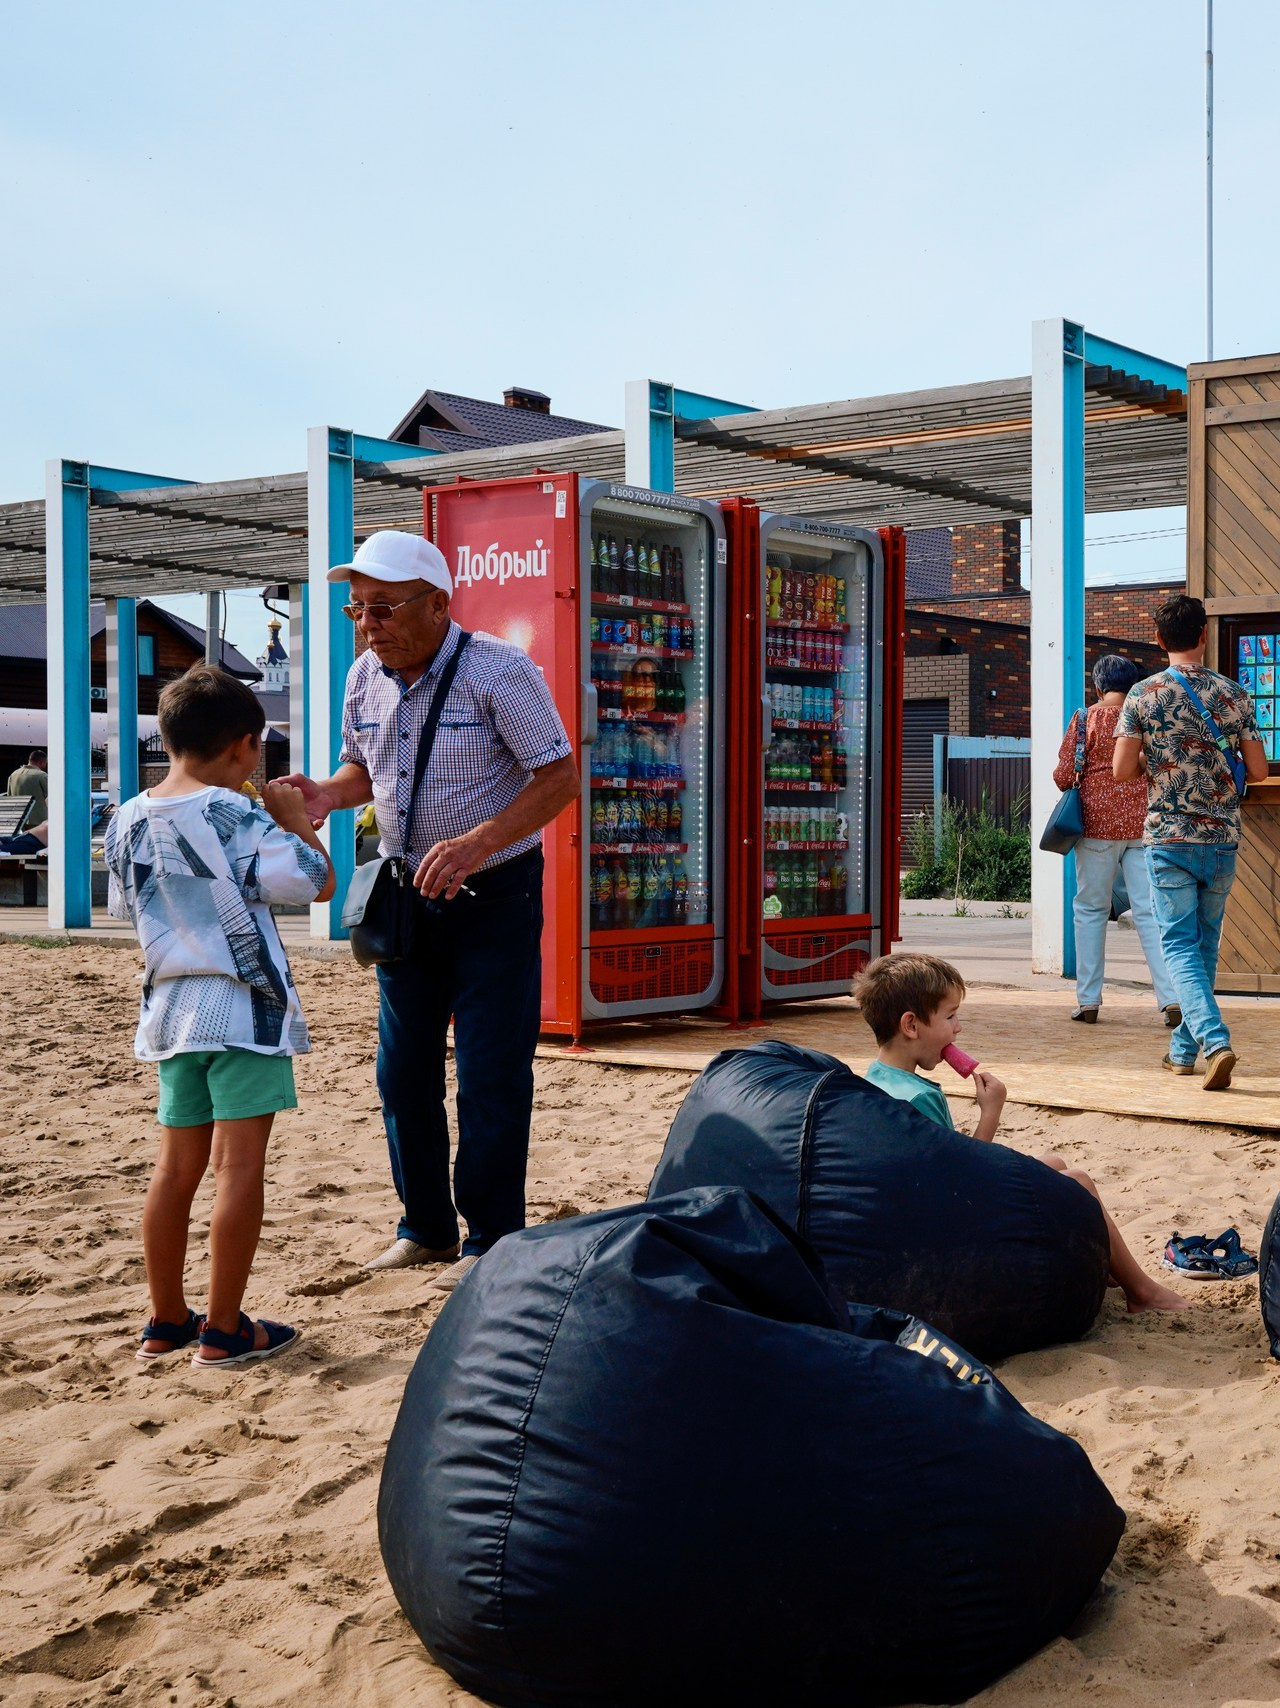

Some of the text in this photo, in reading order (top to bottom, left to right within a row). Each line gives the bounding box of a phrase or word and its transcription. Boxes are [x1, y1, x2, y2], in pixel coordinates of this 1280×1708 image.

[610, 487, 616, 496] 8
[617, 488, 634, 498] 800
[634, 491, 651, 501] 700
[652, 494, 670, 505] 7777
[804, 523, 841, 534] 8-800-700-7777
[454, 538, 547, 588] Добрый
